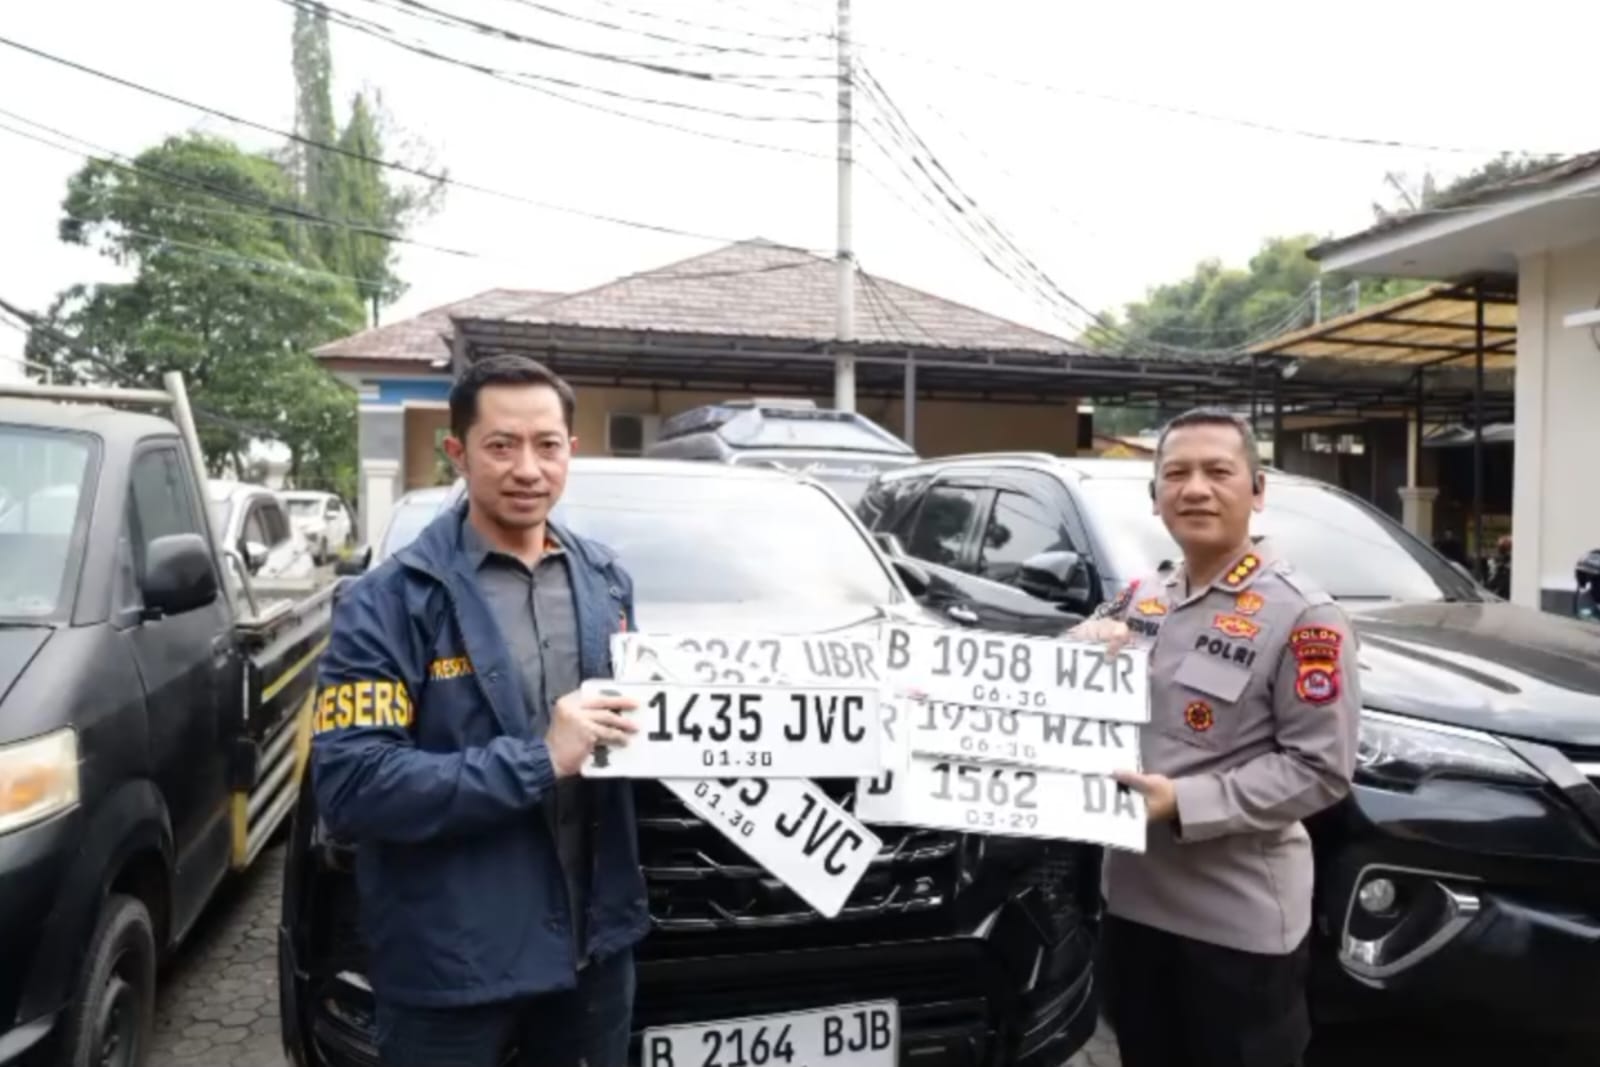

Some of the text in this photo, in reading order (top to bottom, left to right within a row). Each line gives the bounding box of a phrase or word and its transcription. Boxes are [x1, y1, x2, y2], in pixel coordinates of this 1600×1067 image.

[802, 640, 880, 681] UBR
[887, 629, 1135, 694] B 1958 WZR
[1195, 635, 1256, 667] POLRI
[648, 691, 762, 742] 1435
[784, 694, 866, 744] JVC
[703, 750, 773, 767] 01.30
[930, 763, 1038, 809] 1562
[775, 792, 864, 877] JVC
[701, 1024, 795, 1067] 2164
[823, 1010, 891, 1056] BJB
